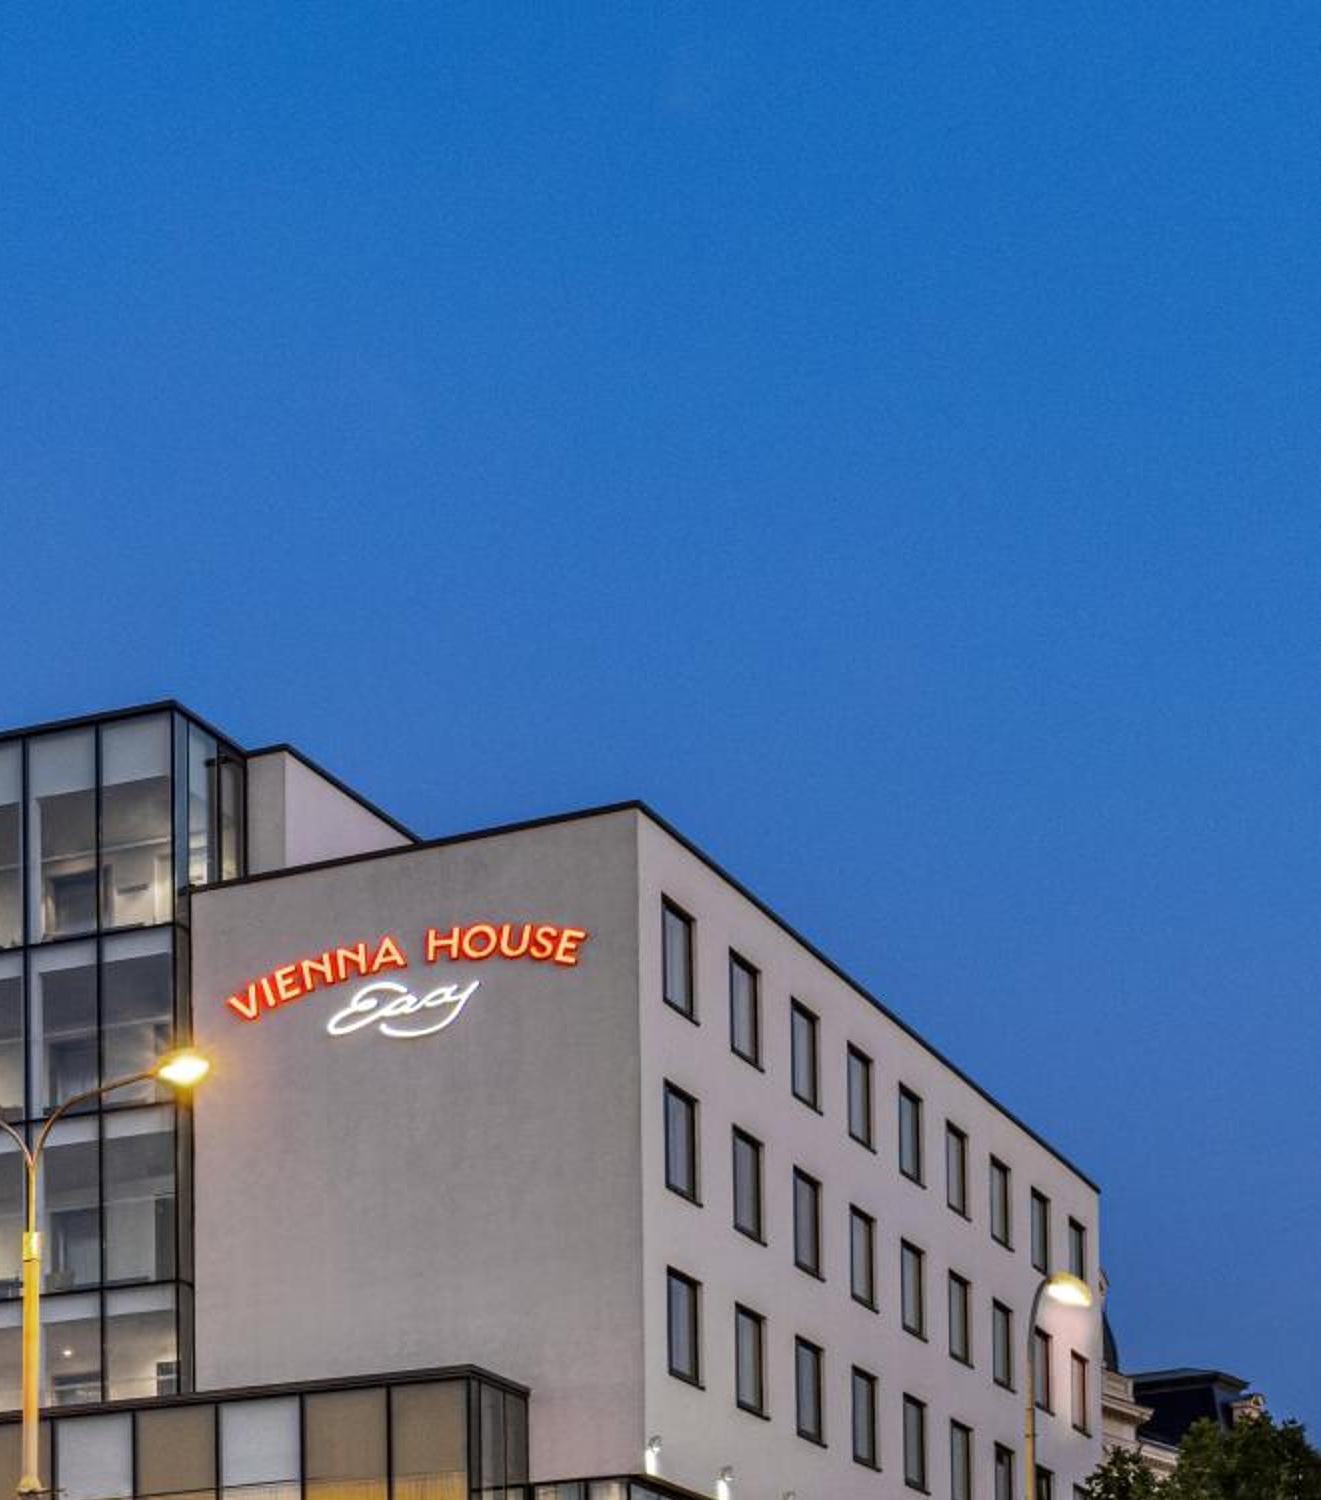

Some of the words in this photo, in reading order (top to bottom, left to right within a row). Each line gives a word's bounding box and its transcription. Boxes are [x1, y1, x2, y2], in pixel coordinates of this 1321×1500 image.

[227, 936, 406, 1021] VIENNA
[425, 923, 586, 966] HOUSE
[326, 981, 479, 1037] Easy
